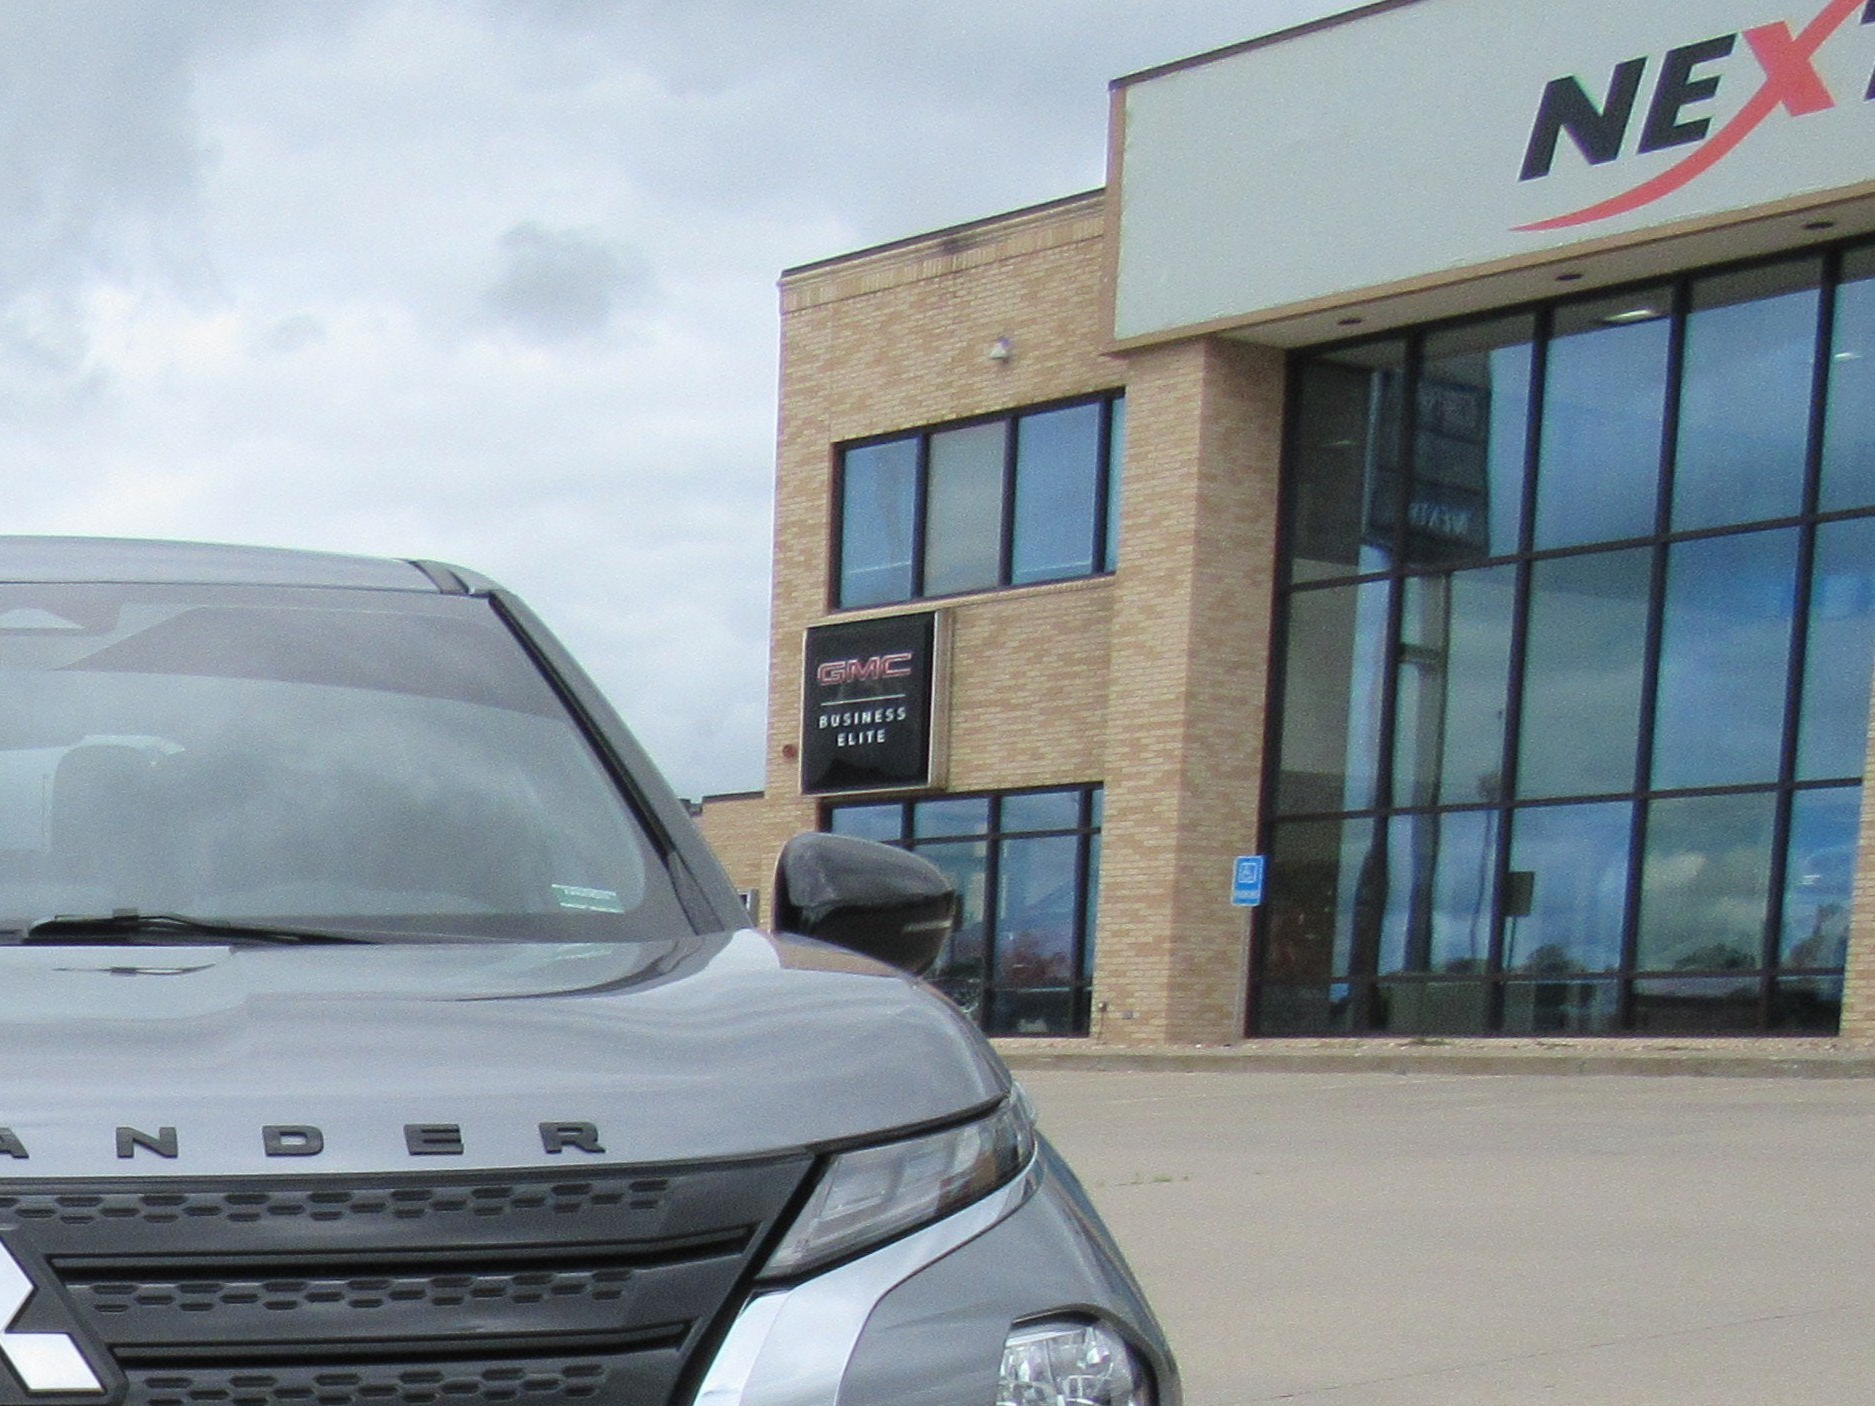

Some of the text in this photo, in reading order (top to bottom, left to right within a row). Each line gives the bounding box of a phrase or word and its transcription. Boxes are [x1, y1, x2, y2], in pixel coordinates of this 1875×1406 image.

[817, 652, 912, 686] GMC
[819, 707, 906, 728] BUSINESS
[837, 729, 886, 747] ELITE
